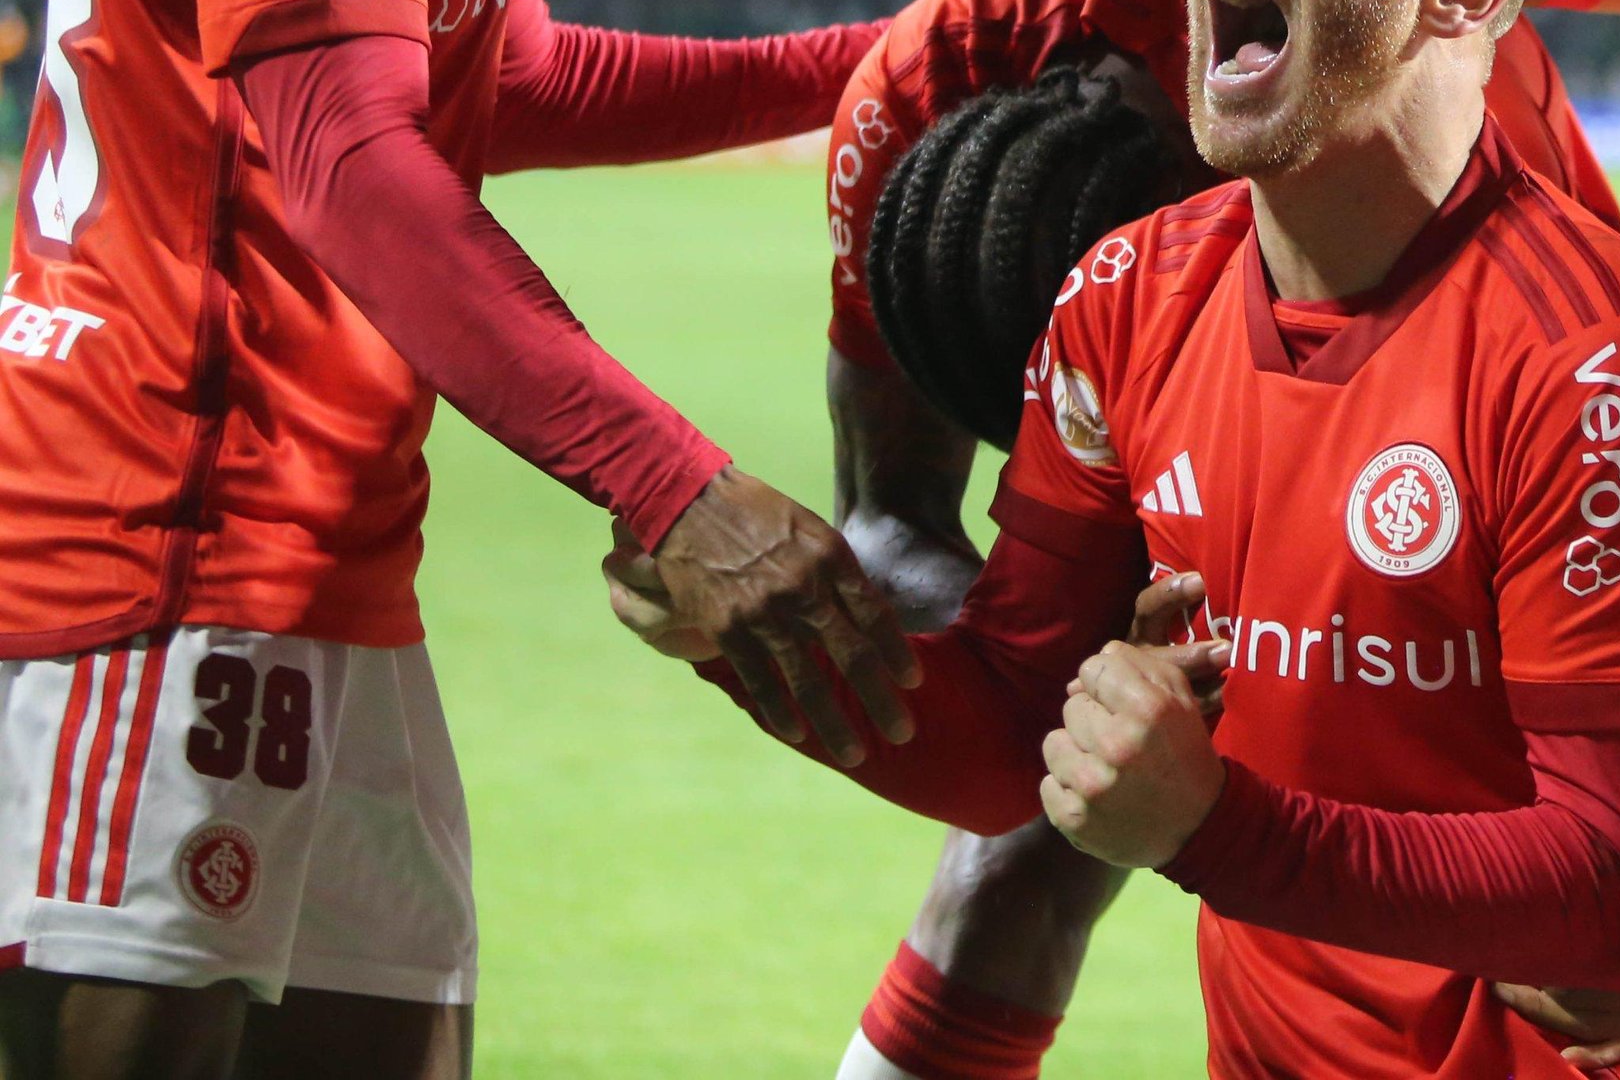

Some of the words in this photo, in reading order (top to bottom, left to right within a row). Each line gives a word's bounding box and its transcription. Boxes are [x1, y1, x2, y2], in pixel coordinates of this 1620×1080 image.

[0, 294, 107, 361] BET
[1376, 452, 1453, 513] INTERNACIONAL
[1378, 555, 1411, 569] 1909
[186, 652, 313, 791] 38
